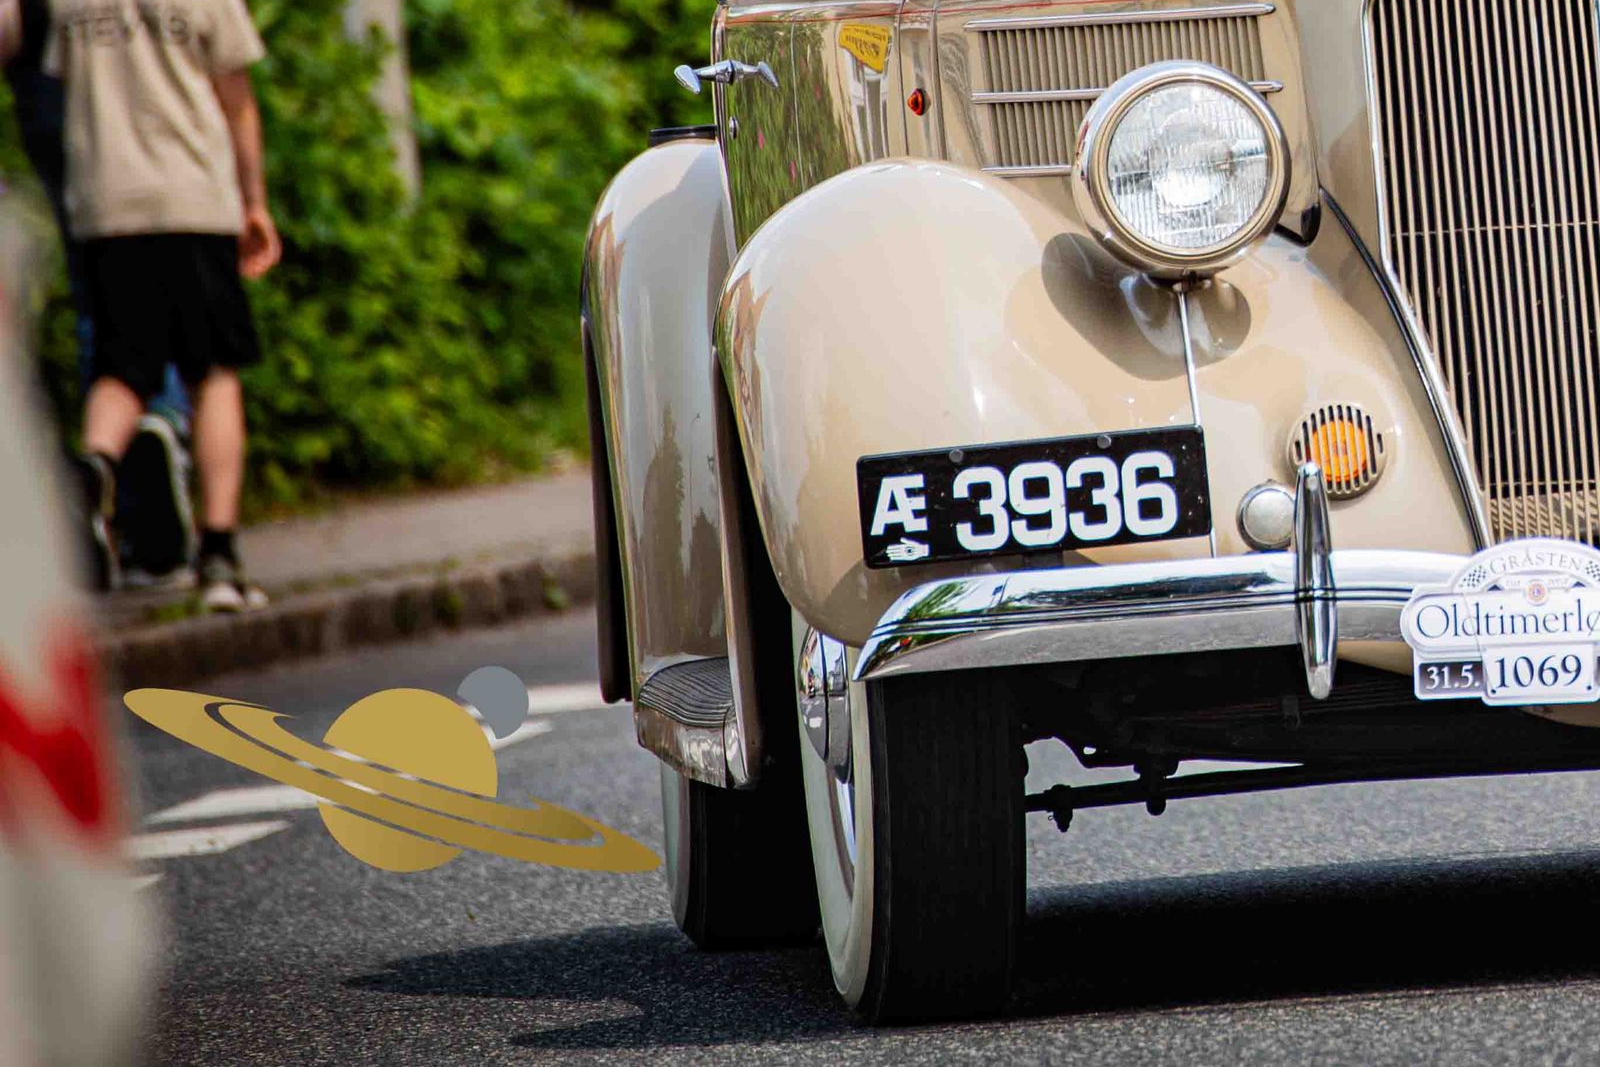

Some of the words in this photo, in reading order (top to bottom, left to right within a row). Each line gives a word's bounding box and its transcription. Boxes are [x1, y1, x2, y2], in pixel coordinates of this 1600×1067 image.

[869, 472, 929, 536] Æ
[952, 448, 1180, 552] 3936
[1489, 547, 1582, 575] GRÅSTEN
[1426, 664, 1480, 690] 31.5.
[1494, 654, 1582, 689] 1069
